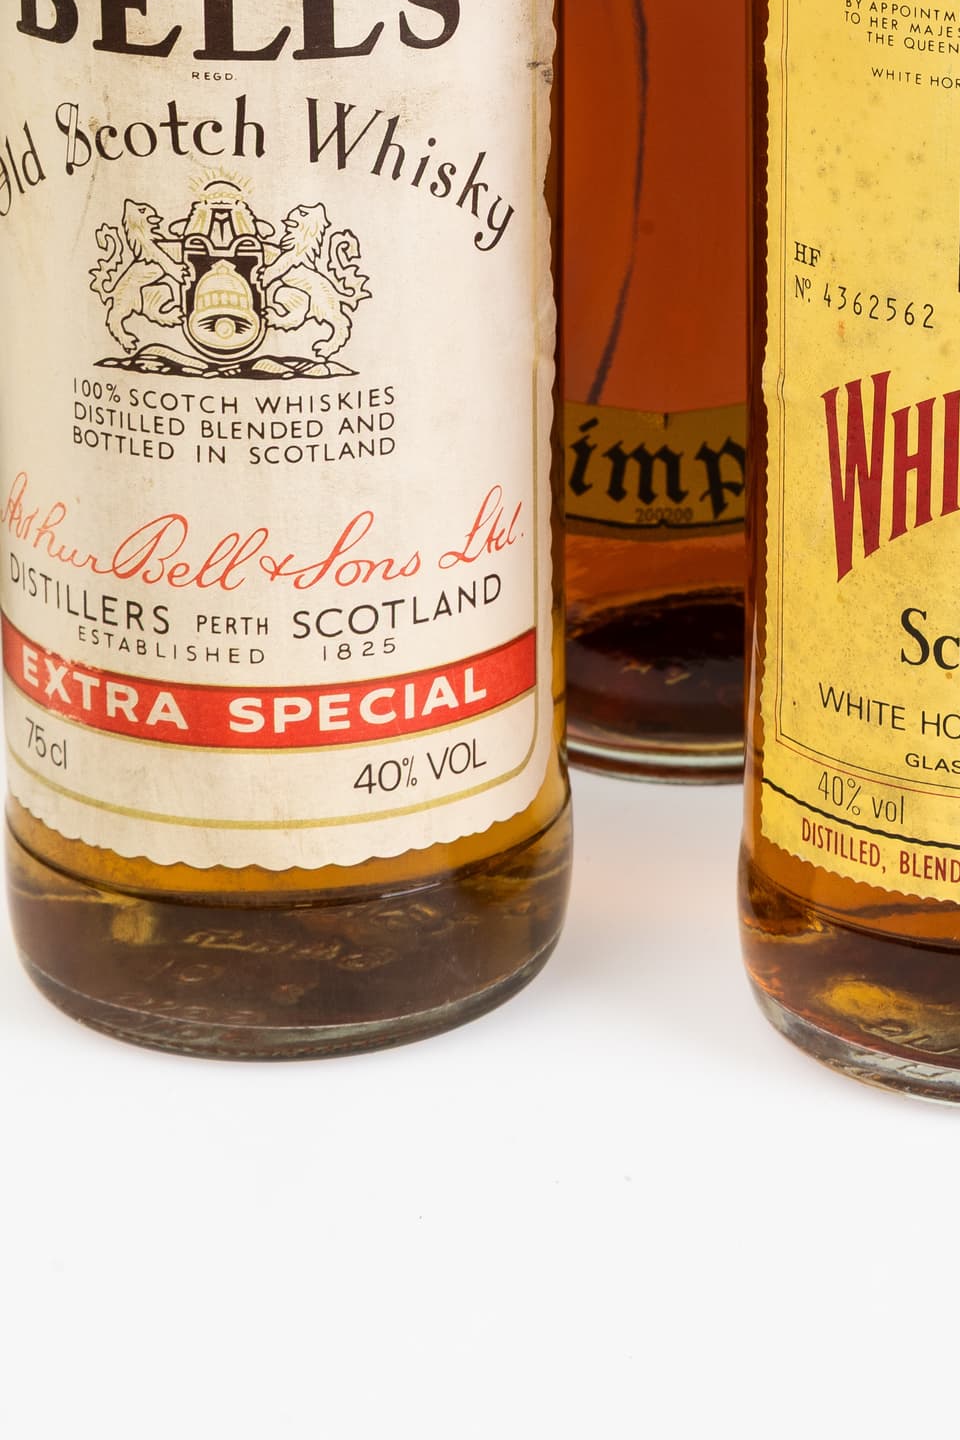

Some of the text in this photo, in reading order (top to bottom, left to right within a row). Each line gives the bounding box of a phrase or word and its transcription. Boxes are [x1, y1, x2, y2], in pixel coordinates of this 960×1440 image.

[844, 10, 862, 25] TO
[869, 16, 899, 31] HER
[866, 30, 960, 54] THE QUEEN
[871, 66, 923, 86] WHITE
[54, 93, 516, 252] Scotch Whisky
[793, 240, 822, 269] HF
[822, 282, 936, 329] 4362562
[73, 377, 395, 414] 100% SCOTCH WHISKIES
[74, 401, 395, 440] DISTILLED BLENDED AND
[72, 425, 396, 465] BOTTLED IN SCOTLAND
[104, 512, 268, 591] Bell
[292, 510, 421, 591] Sons
[9, 552, 502, 640] DISTILLERS PERTH SCOTLAND
[78, 625, 397, 665] ESTABLISHED 1825
[20, 645, 488, 734] EXTRA SPECIAL
[818, 682, 906, 732] WHITE
[24, 717, 69, 770] 75cl
[353, 737, 488, 795] 40% VOL
[817, 770, 905, 825] 40% vol
[801, 816, 887, 875] DISTILLED,
